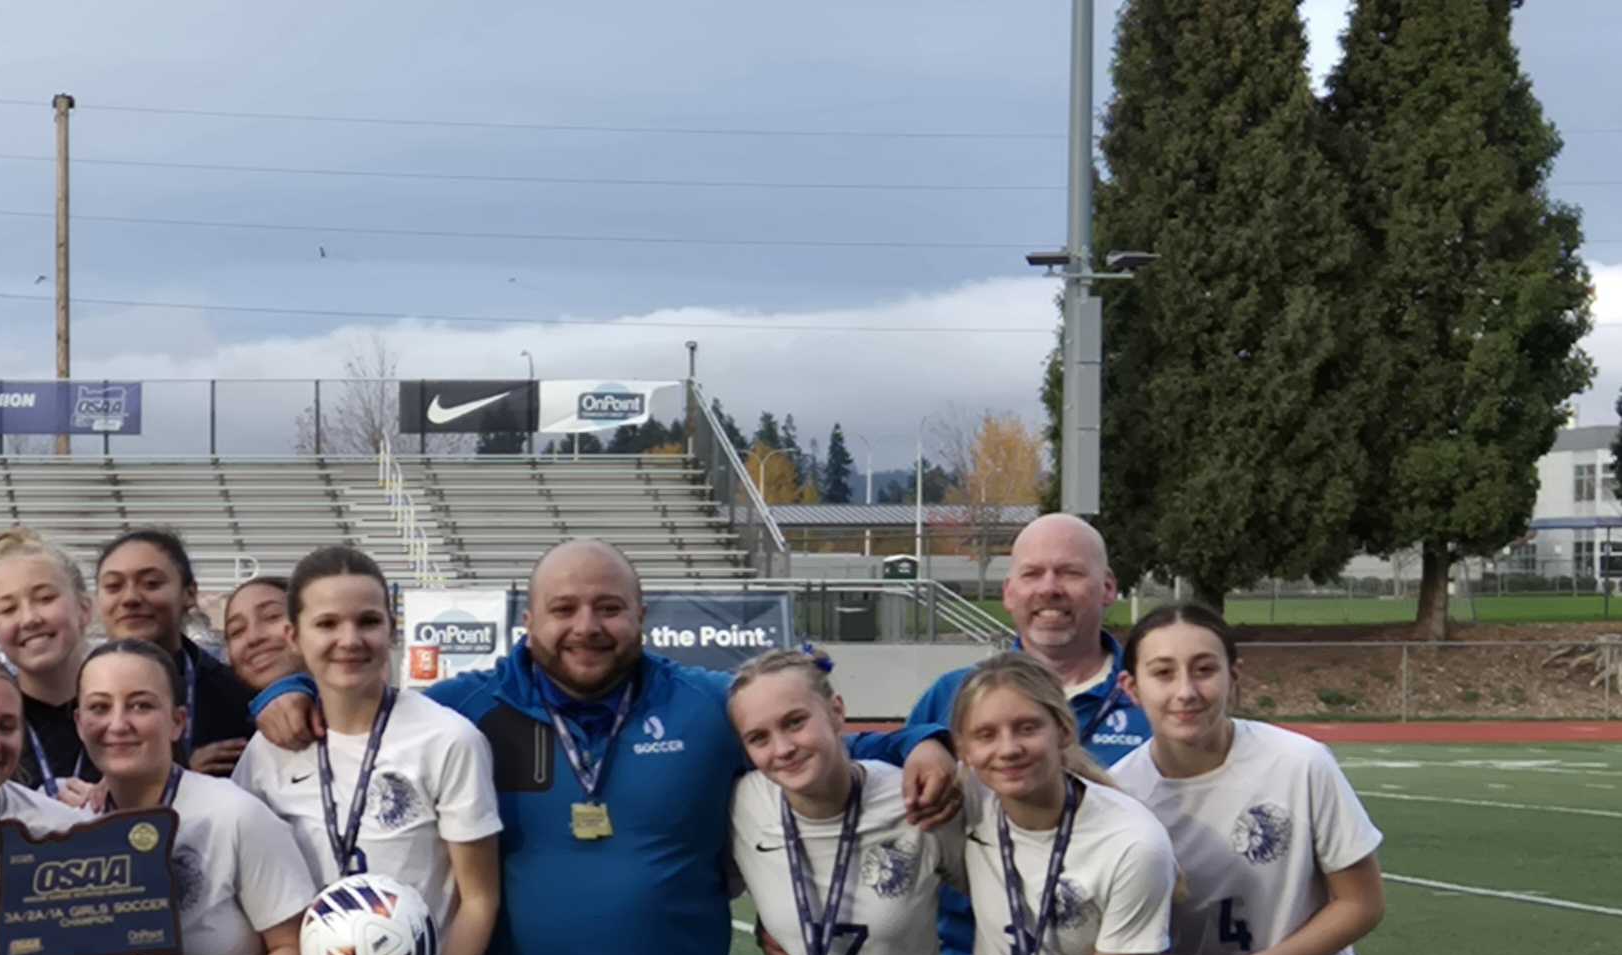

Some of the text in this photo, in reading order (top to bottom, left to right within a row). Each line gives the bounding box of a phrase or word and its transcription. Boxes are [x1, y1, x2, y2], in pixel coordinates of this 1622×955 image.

[582, 395, 640, 411] OnPoint
[420, 625, 492, 644] OnPoint
[650, 626, 696, 647] the
[633, 740, 684, 754] SOCCER
[1092, 733, 1143, 746] SOCCER
[33, 854, 131, 896] OSAA
[113, 898, 169, 914] SOCCER
[1218, 896, 1253, 951] 4
